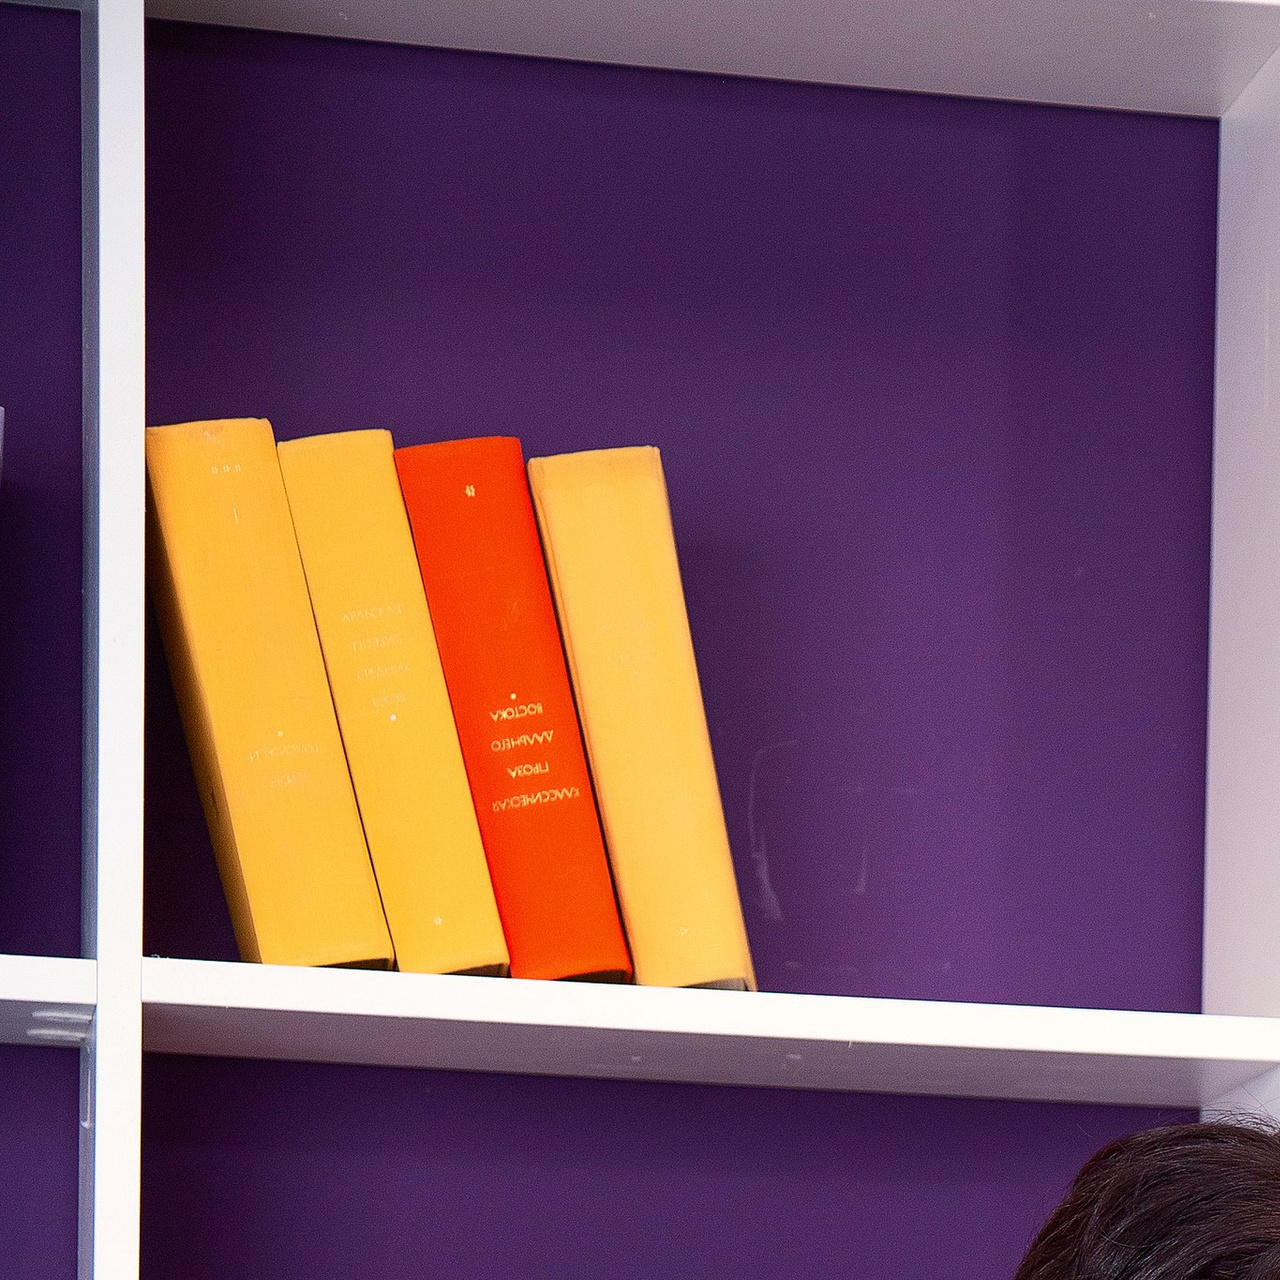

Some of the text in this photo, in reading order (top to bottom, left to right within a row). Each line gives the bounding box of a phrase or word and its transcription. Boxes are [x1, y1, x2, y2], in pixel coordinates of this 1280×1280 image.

[489, 702, 544, 723] ВОСТОКА
[490, 729, 555, 752] ДАЛЬНЕГО
[506, 761, 550, 779] ПРОЗА
[491, 786, 580, 813] КЛАССИЧЕСКАЯ
